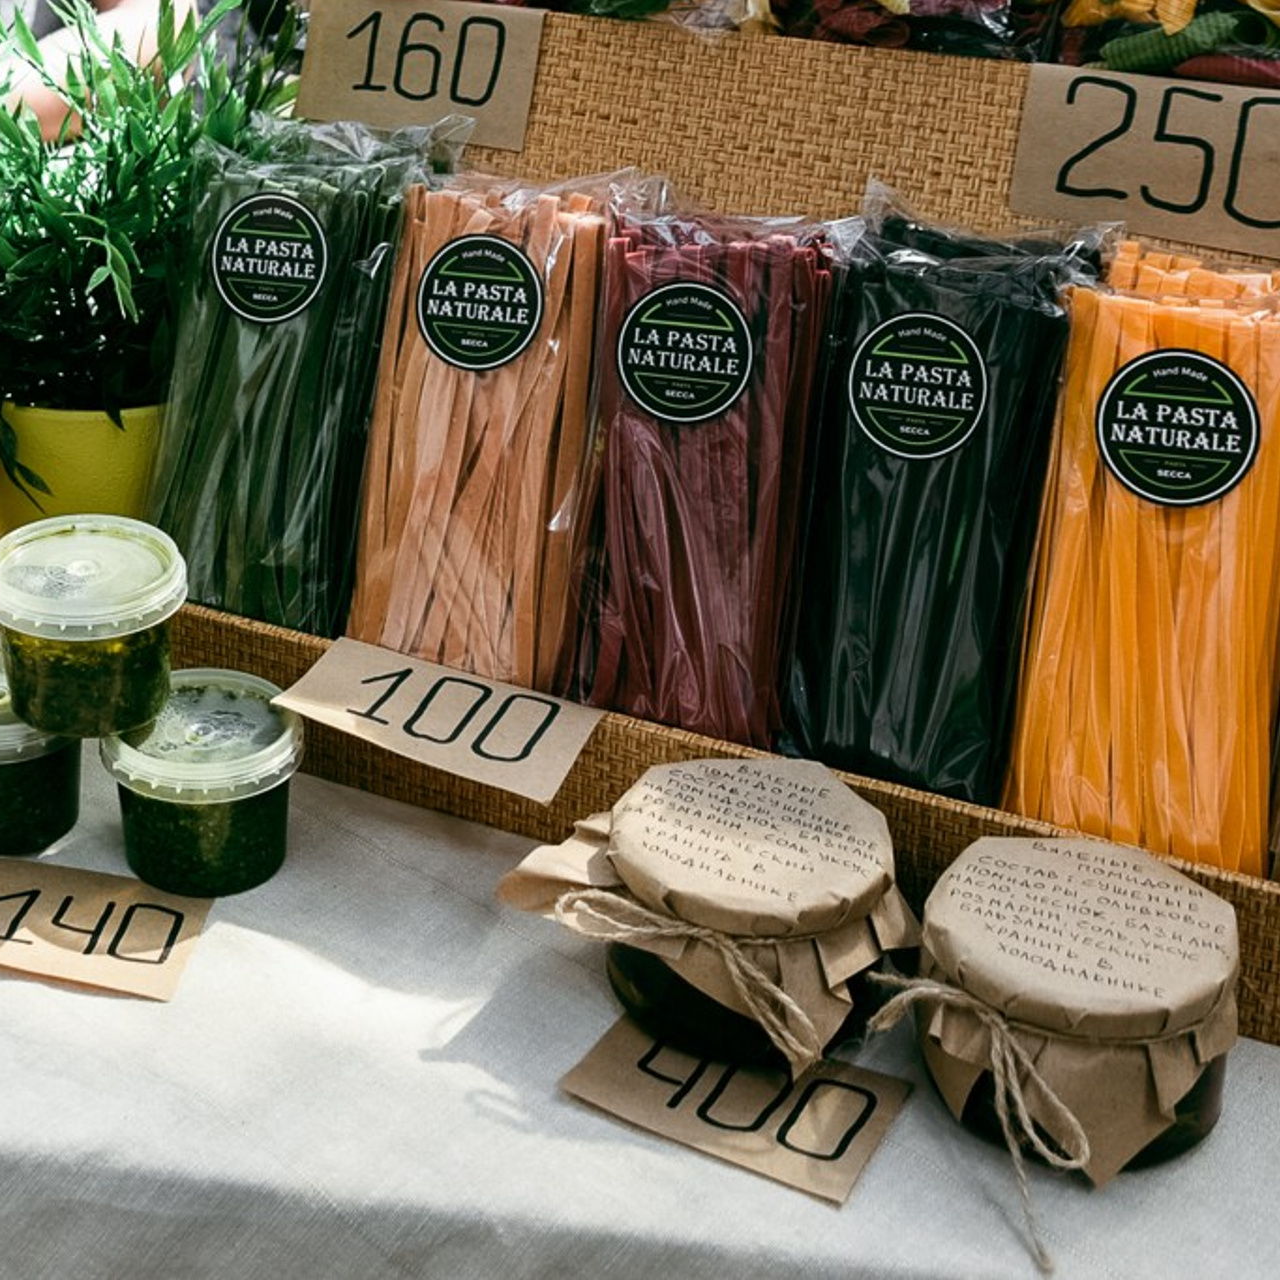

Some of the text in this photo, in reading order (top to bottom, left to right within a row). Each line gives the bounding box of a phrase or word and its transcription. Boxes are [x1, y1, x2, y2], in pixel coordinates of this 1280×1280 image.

[346, 10, 506, 107] 160
[225, 236, 314, 259] LA PASTA
[220, 255, 316, 279] NATURALE
[432, 279, 528, 304] LA PASTA
[426, 299, 530, 325] NATURALE
[633, 327, 738, 354] LA PASTA
[898, 327, 947, 342] Hand Made
[627, 348, 740, 375] NATURALE
[866, 359, 972, 388] LA PASTA
[1153, 367, 1208, 382] Hand Made
[665, 389, 695, 399] SECCA
[859, 381, 974, 411] NATURALE
[1117, 400, 1239, 430] LA PASTA
[899, 425, 931, 436] SECCA
[1110, 423, 1242, 454] NATURALE
[1157, 469, 1192, 480] SECCA
[346, 668, 561, 762] 100
[1032, 840, 1142, 871] ВЯЛЕНЫЕ
[1077, 863, 1203, 898] ПОМИДОРЫ
[1082, 878, 1199, 911] СУШЕНЫЕ
[1097, 895, 1226, 934] ОЛИВКОВОЕ
[960, 902, 1150, 964] БАЛЬЗАМИЧЕСКИЙ
[984, 923, 1112, 971] ХРАНИТЬ В
[997, 941, 1166, 999] ХОЛОДИЛЬНИКЕ
